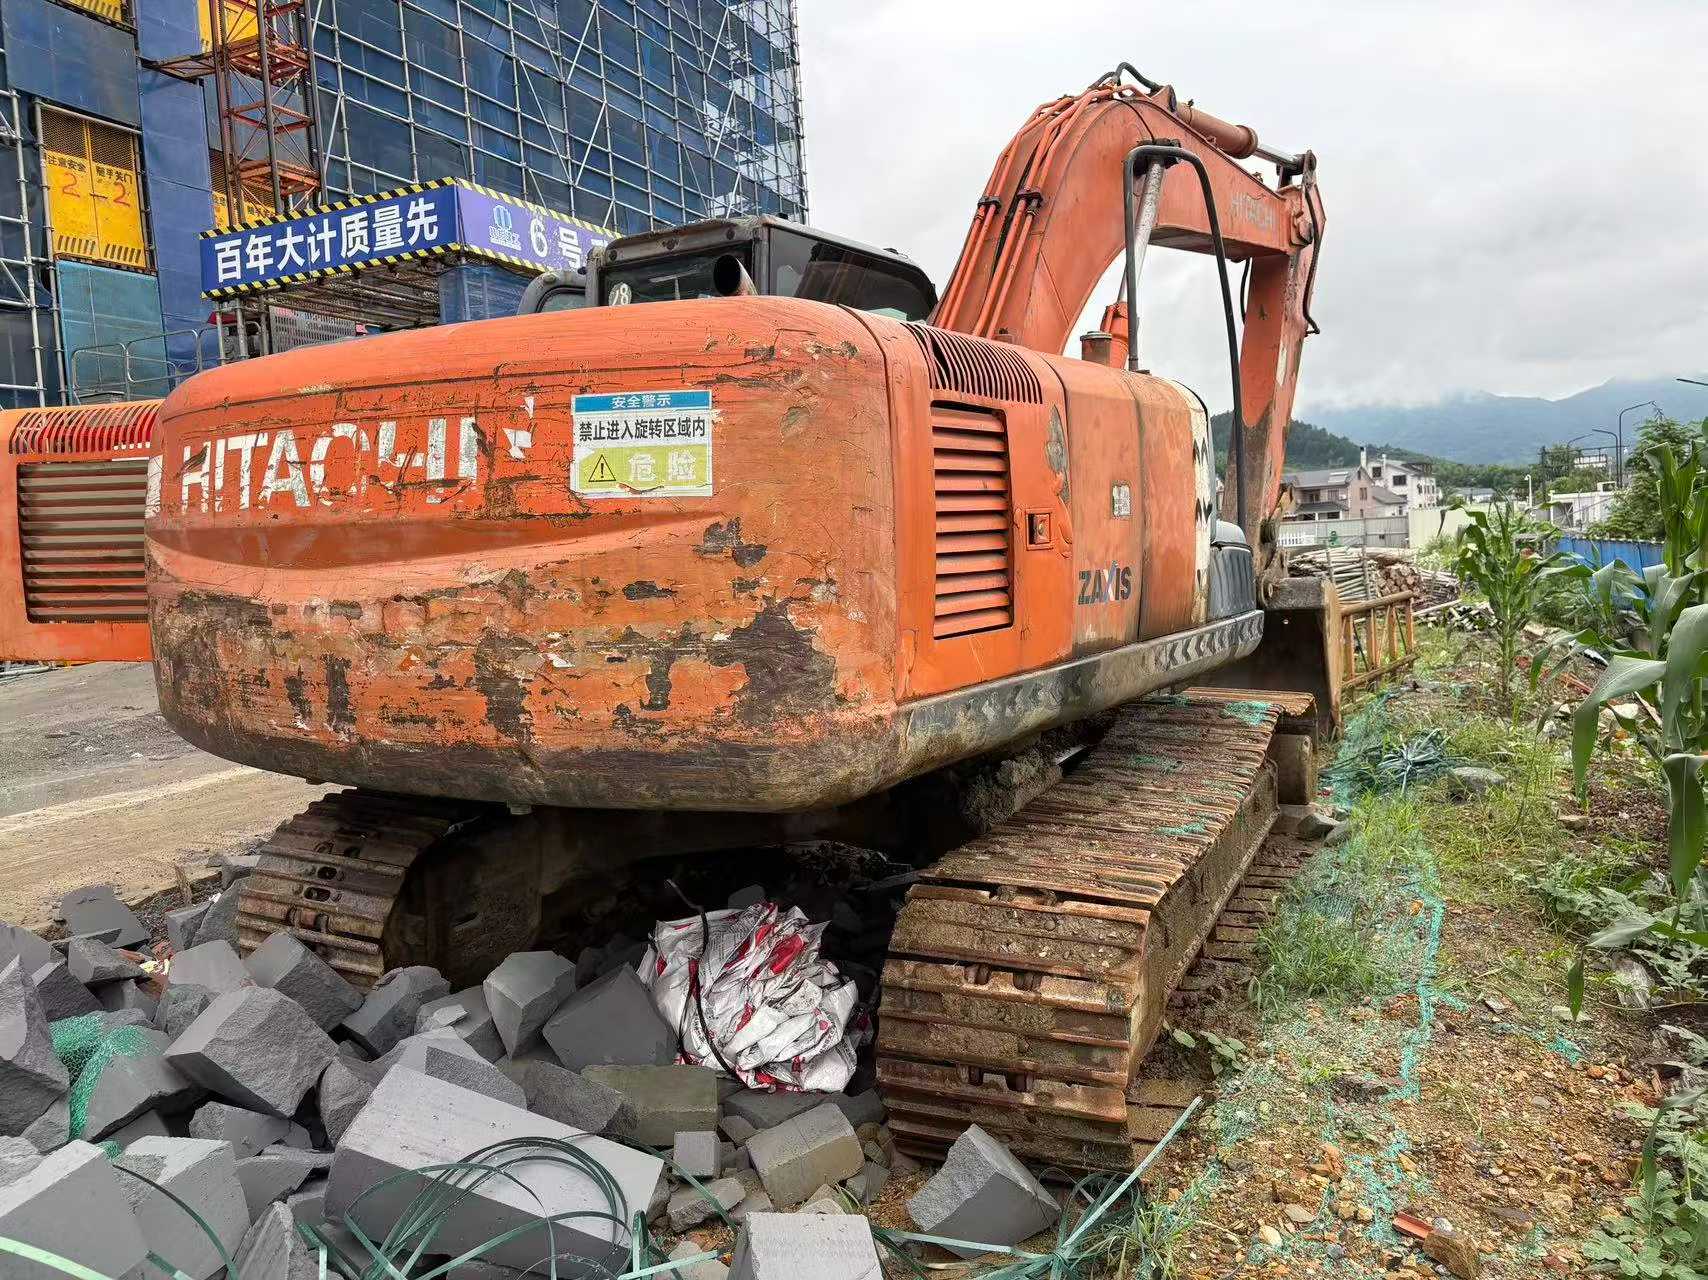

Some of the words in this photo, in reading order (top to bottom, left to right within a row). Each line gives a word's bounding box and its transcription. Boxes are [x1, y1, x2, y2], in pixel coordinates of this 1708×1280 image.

[214, 197, 438, 283] 百年大计质量先
[611, 394, 671, 409] 安全警示
[579, 416, 705, 442] 禁止进入旋转区域内
[628, 451, 696, 482] 危险
[1078, 560, 1132, 605] ZAXIS
